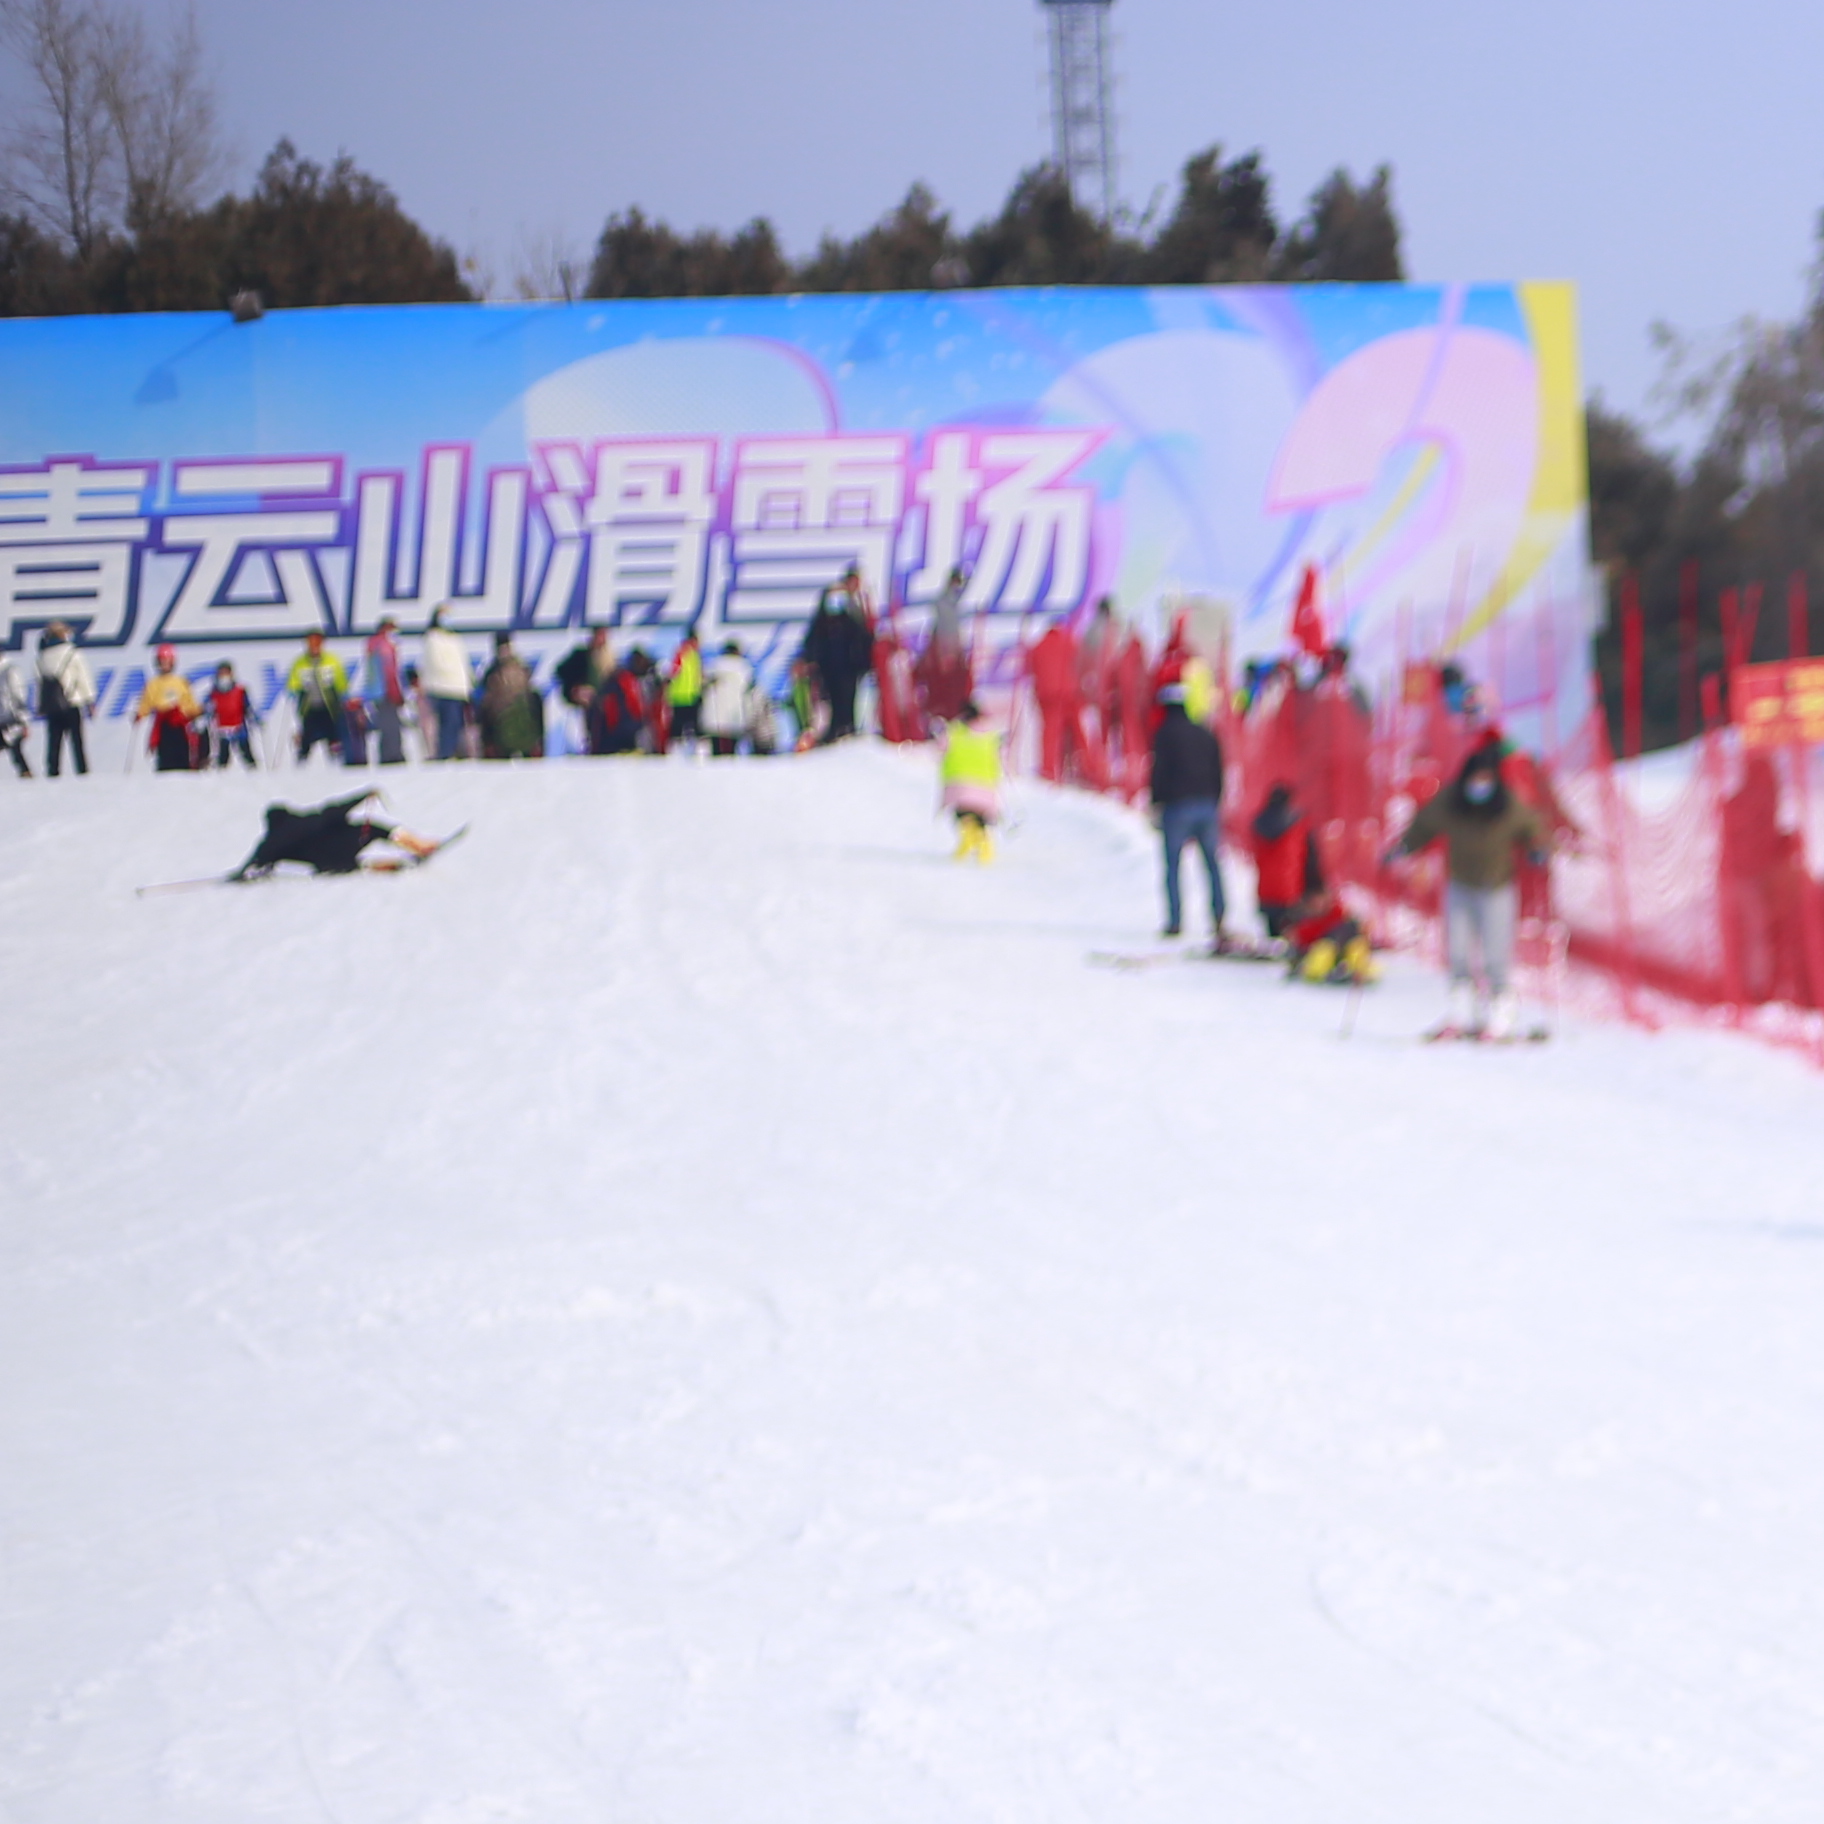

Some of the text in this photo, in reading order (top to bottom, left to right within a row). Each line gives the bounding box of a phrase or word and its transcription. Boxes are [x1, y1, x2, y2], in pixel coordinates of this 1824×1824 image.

[0, 434, 1105, 644] 青云山滑雪场
